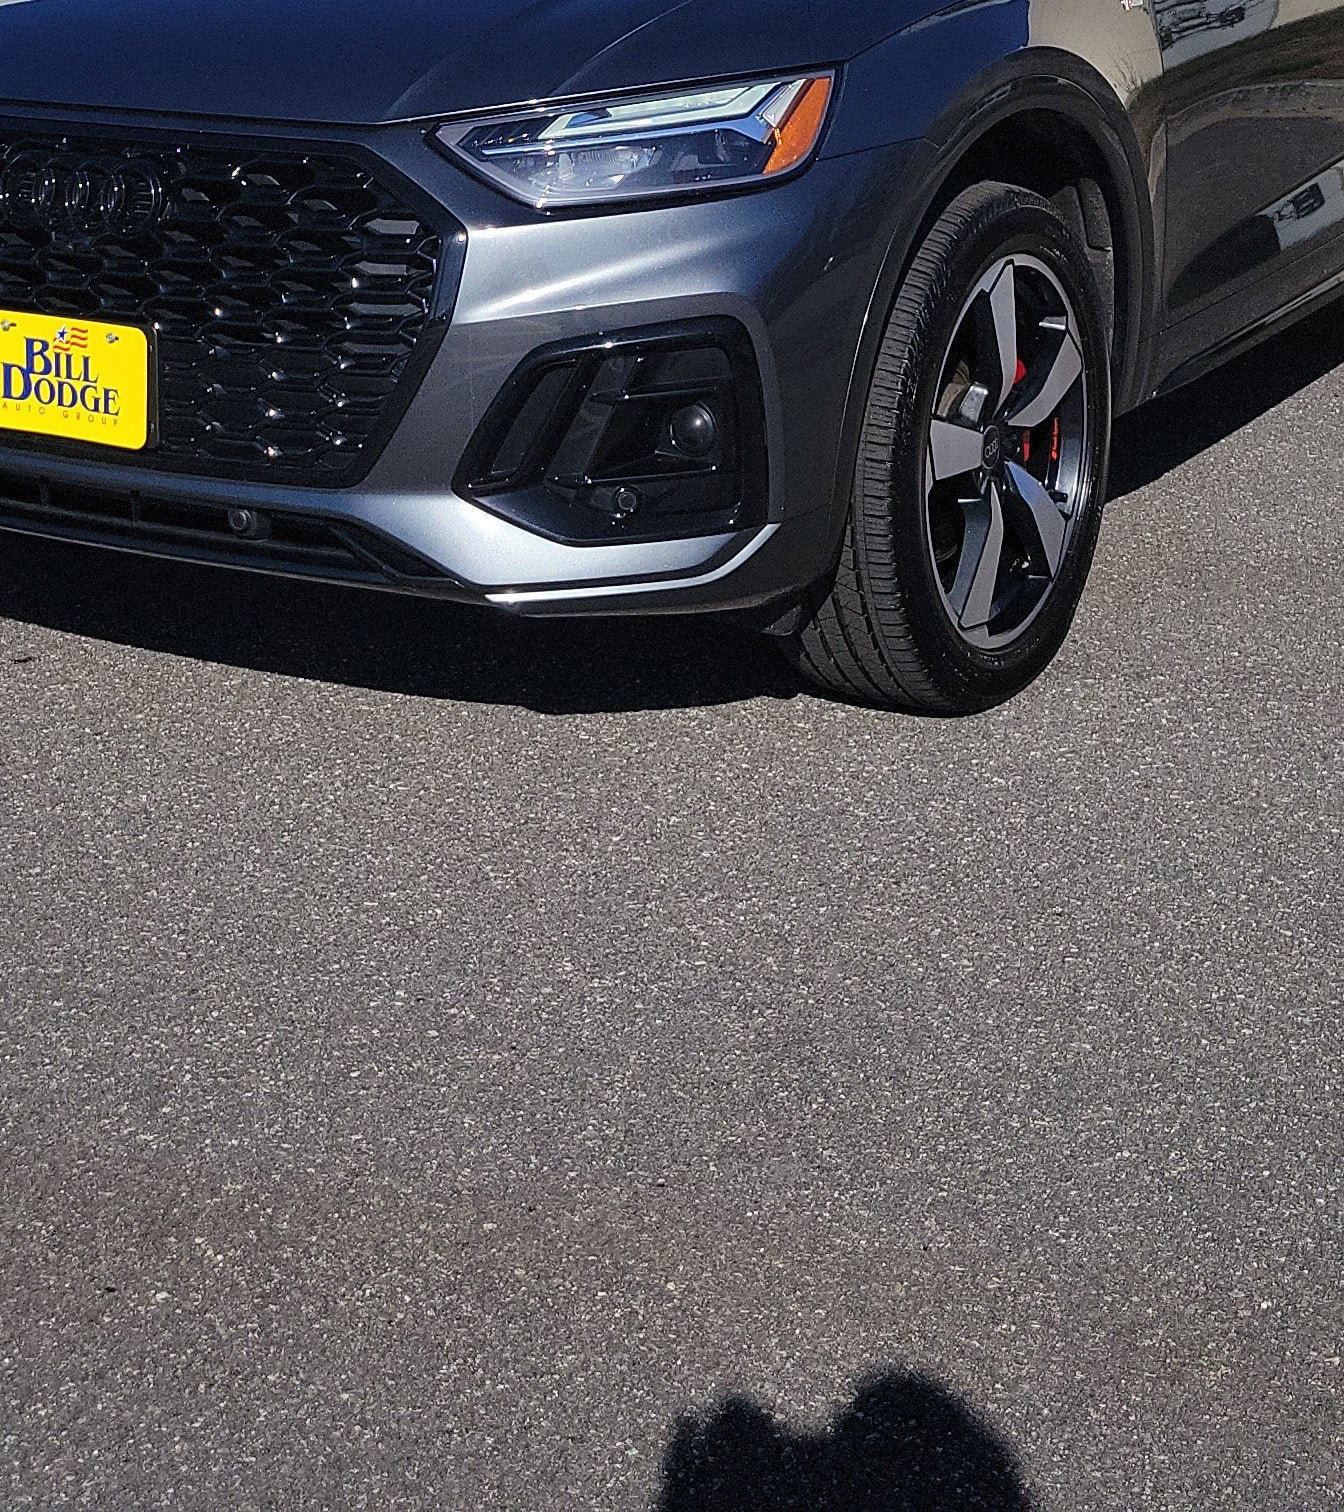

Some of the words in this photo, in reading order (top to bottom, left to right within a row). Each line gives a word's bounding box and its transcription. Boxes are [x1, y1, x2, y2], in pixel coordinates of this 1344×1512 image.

[24, 336, 99, 383] BILL
[1, 362, 120, 416] DODGE
[62, 411, 119, 427] GROUP
